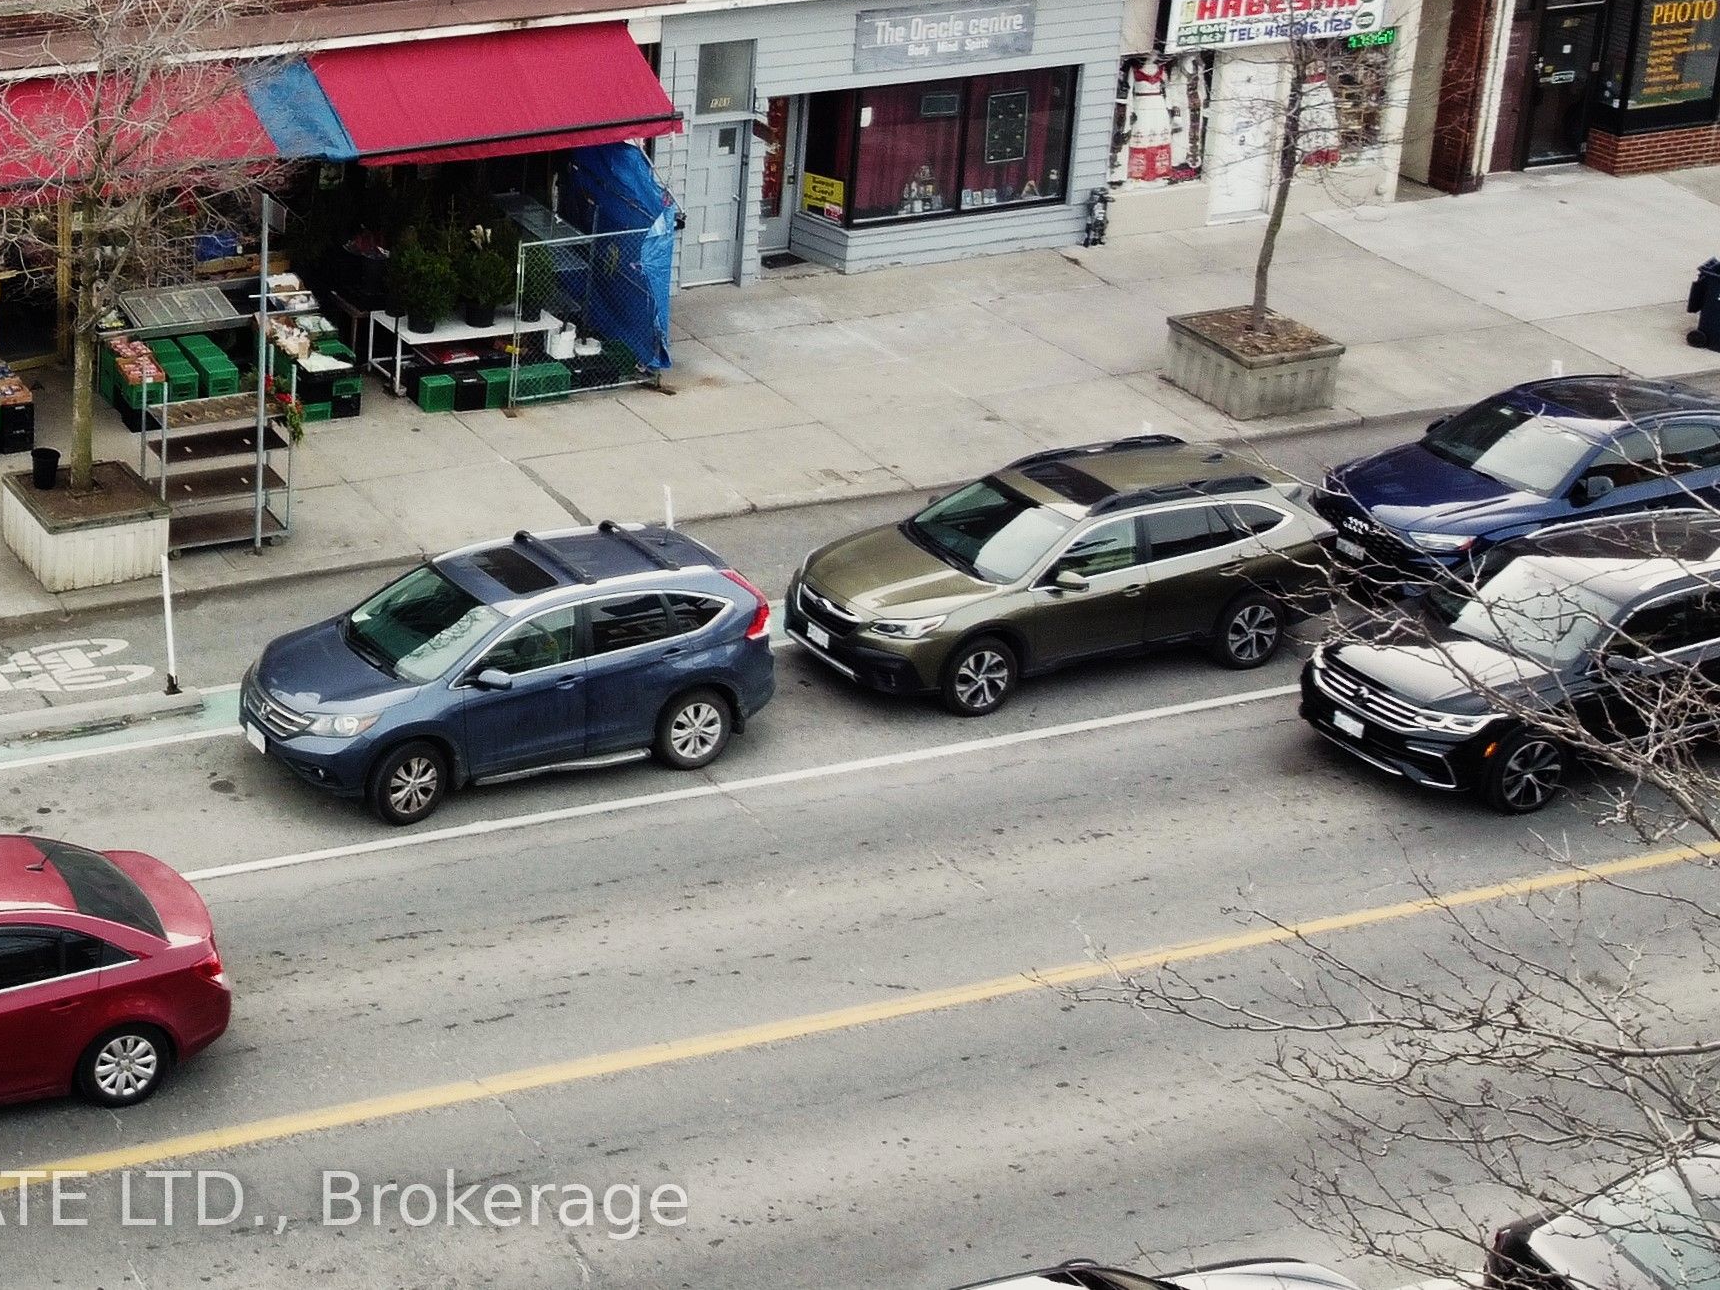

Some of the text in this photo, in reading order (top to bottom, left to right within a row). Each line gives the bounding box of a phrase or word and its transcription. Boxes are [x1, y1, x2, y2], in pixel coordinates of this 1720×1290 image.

[1651, 0, 1717, 25] PHOTO
[874, 11, 1024, 45] The Oracle centre
[1227, 27, 1260, 43] TEL:
[907, 43, 931, 57] Body
[964, 37, 990, 51] Spirit
